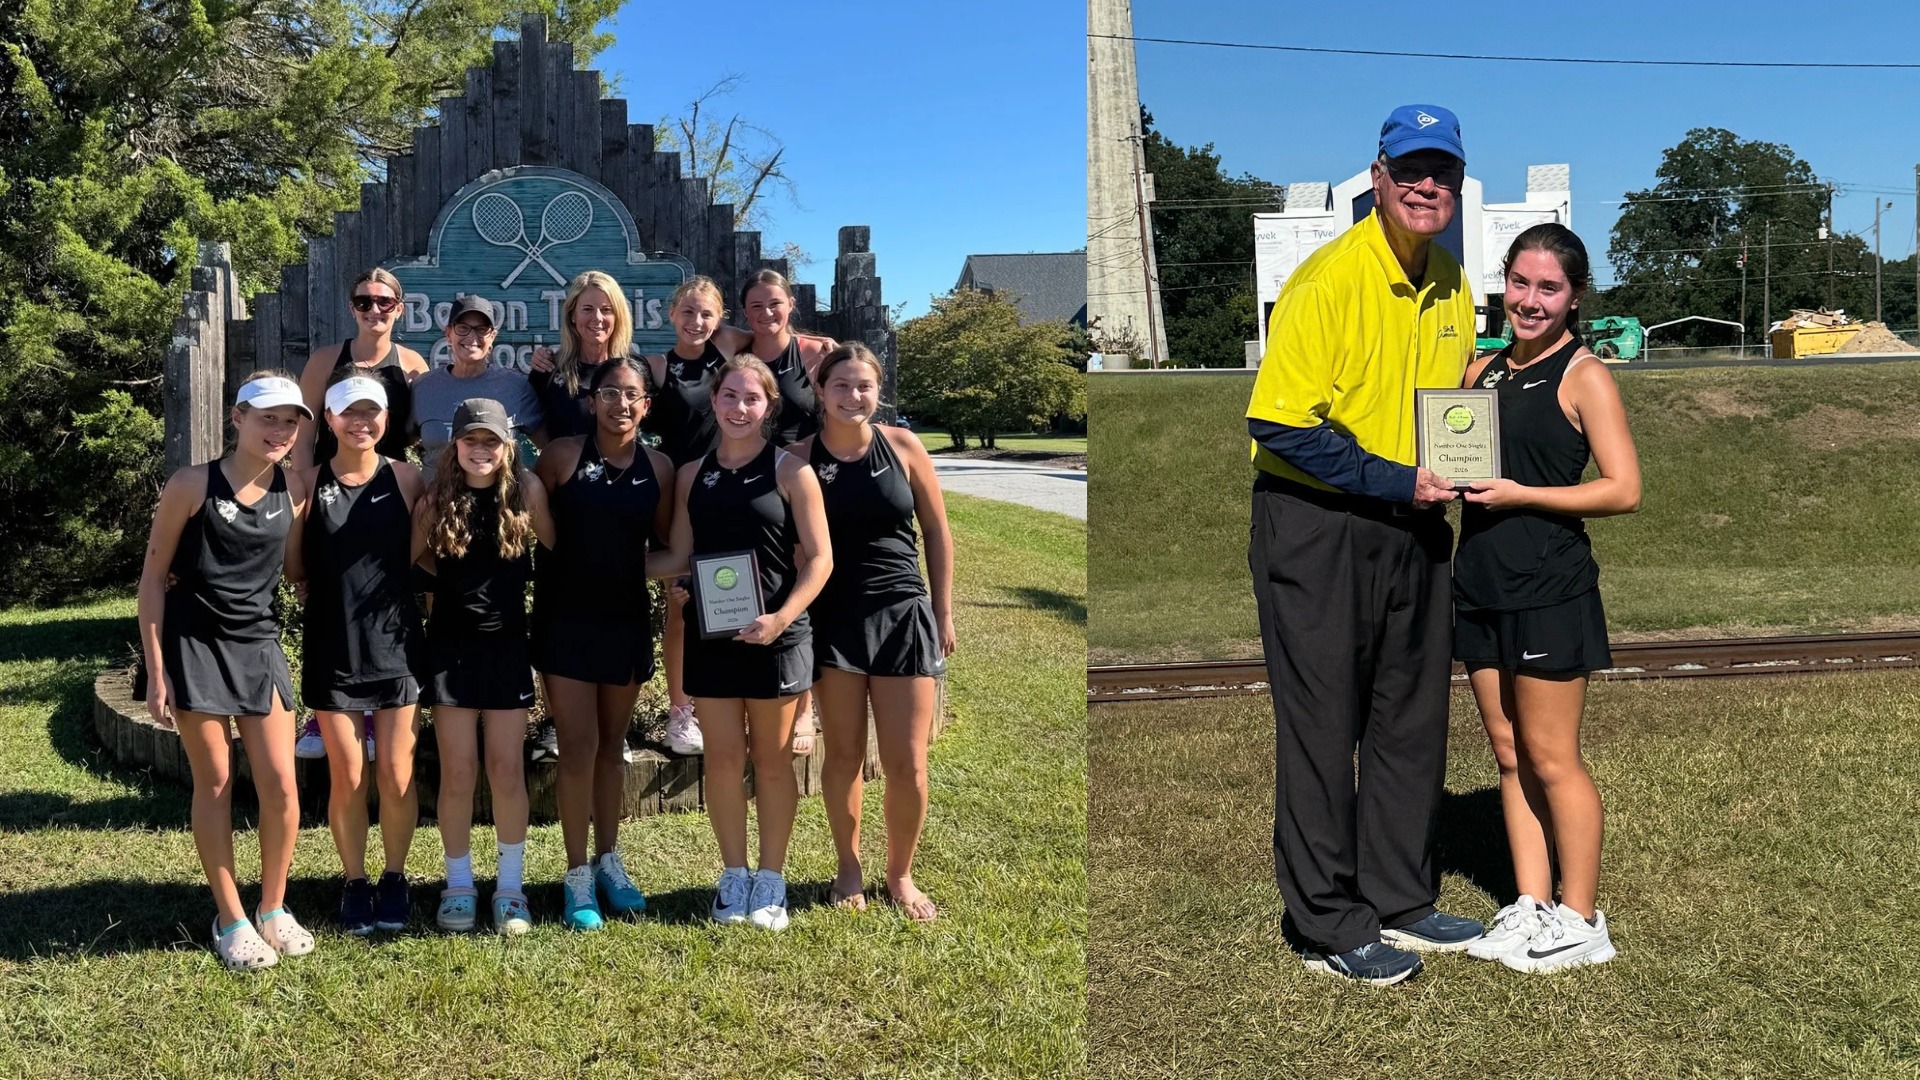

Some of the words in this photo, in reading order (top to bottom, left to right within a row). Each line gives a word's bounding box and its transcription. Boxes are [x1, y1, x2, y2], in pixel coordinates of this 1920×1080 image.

[1493, 221, 1520, 231] Tyvek
[540, 288, 664, 331] Tis
[1468, 442, 1487, 450] Singles
[1438, 453, 1483, 464] Champion
[713, 605, 749, 616] Champion
